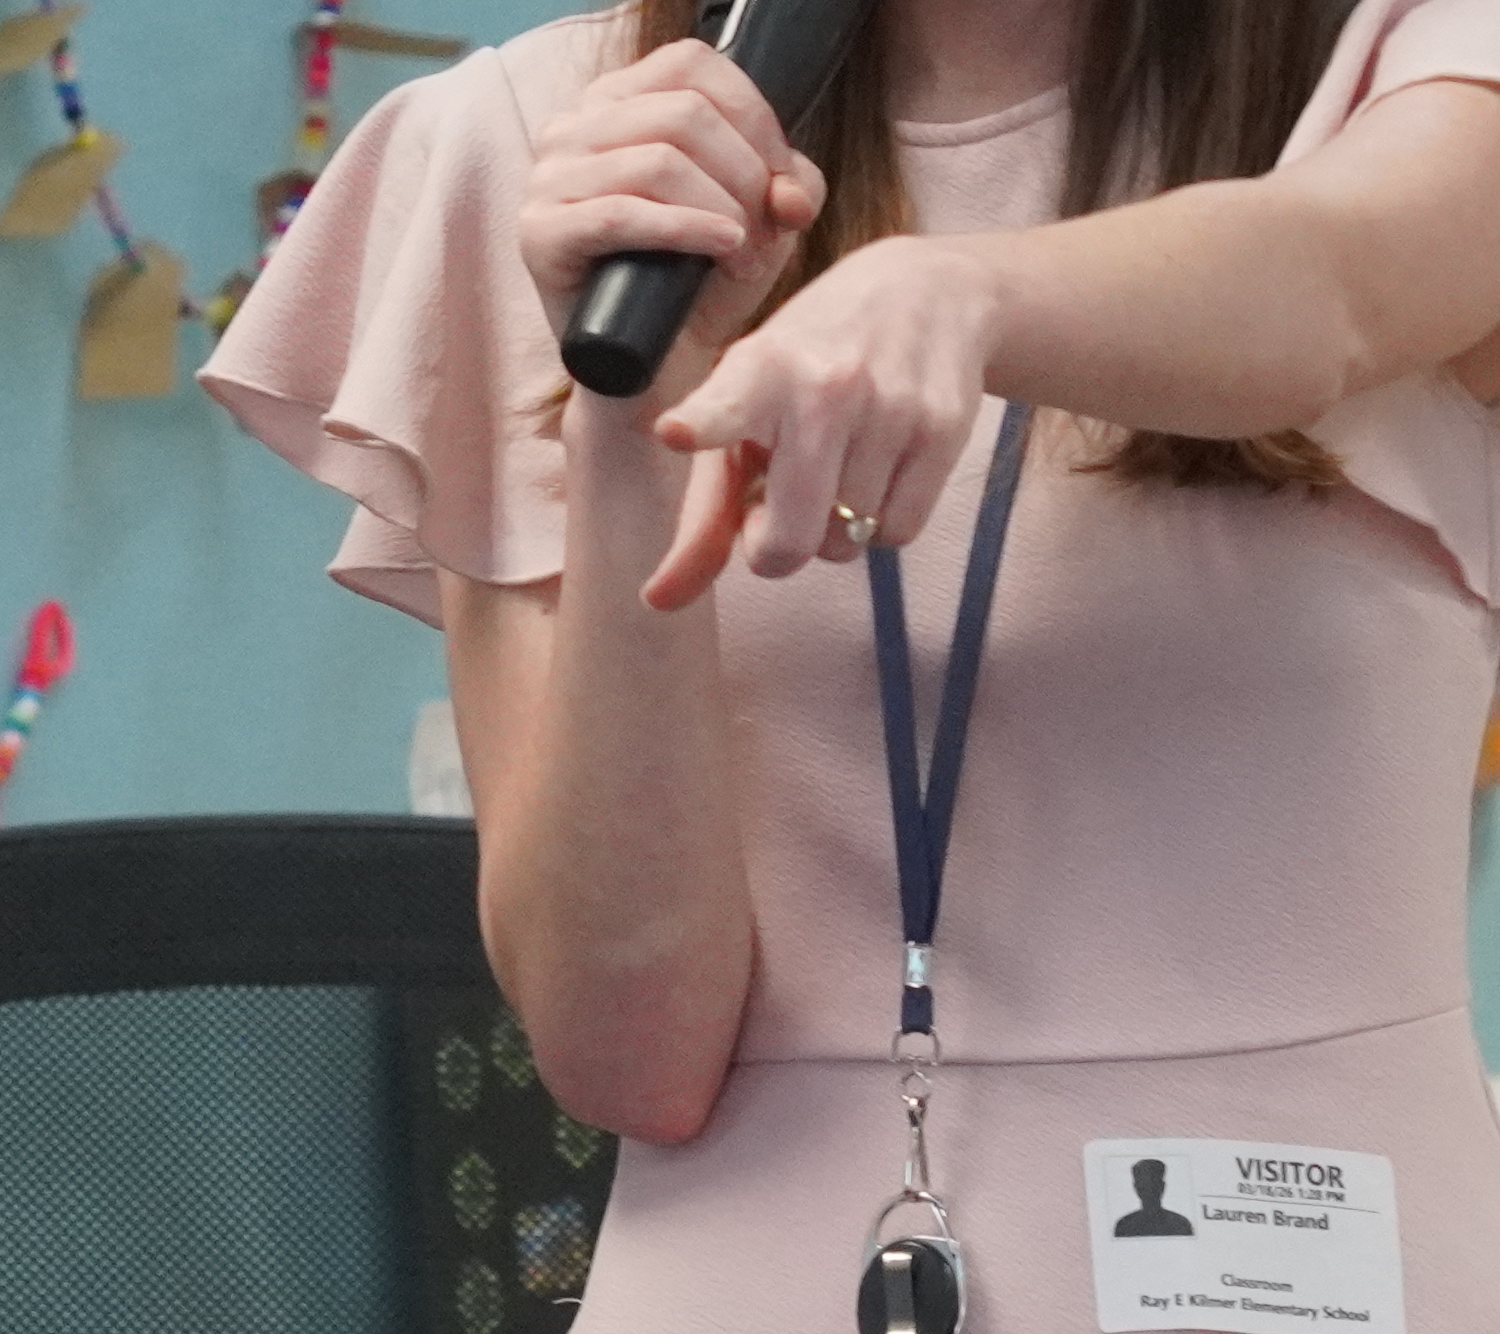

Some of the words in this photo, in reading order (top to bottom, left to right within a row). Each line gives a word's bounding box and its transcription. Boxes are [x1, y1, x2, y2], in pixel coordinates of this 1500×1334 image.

[1235, 1156, 1346, 1189] VISITOR
[1202, 1204, 1267, 1225] Lauren
[1272, 1209, 1330, 1231] Brand
[1221, 1273, 1294, 1293] Classroom
[1140, 1294, 1170, 1310] Ray
[1240, 1297, 1320, 1322] Elementary
[1321, 1305, 1371, 1323] School
